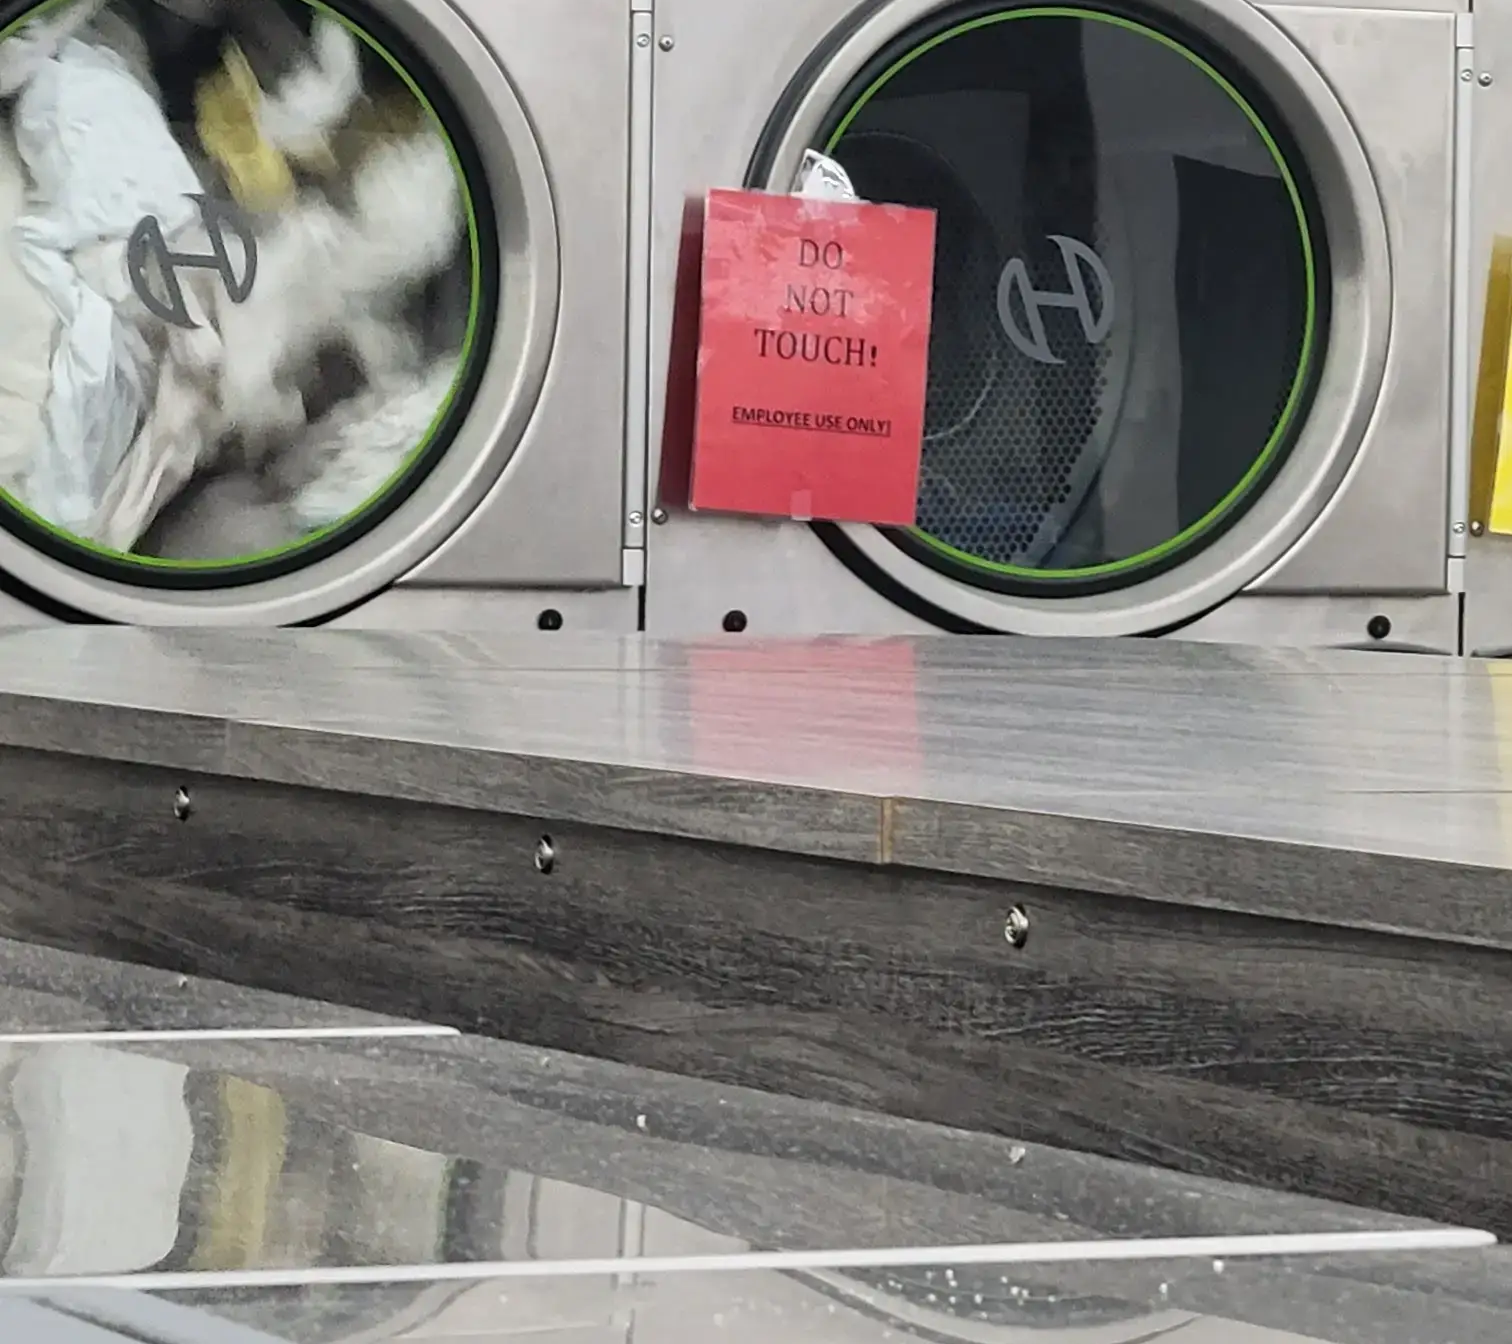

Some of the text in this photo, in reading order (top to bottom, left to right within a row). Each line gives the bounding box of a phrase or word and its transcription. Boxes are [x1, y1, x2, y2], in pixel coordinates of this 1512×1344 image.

[799, 238, 843, 270] DO
[785, 283, 855, 319] NOT
[753, 327, 879, 368] TOUCH!
[731, 406, 892, 437] EMPLOYEE USE ONLY!
